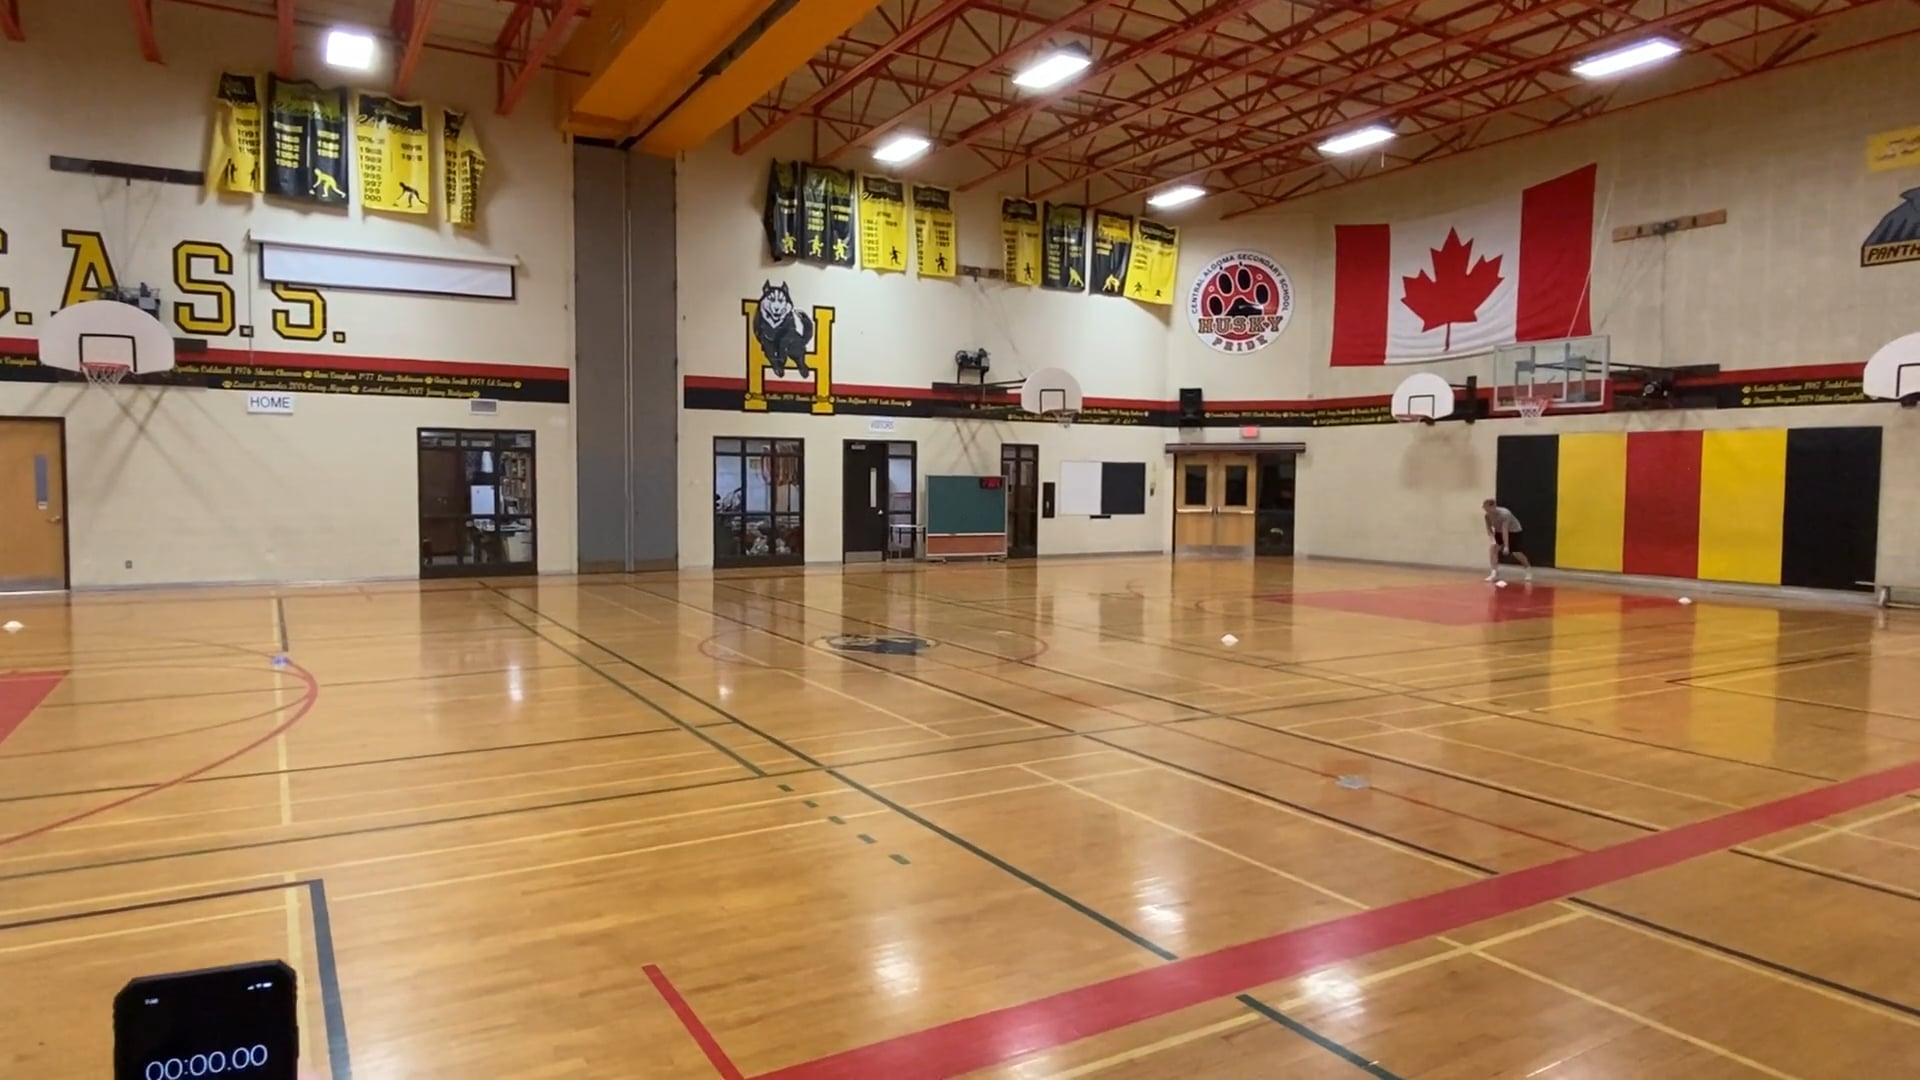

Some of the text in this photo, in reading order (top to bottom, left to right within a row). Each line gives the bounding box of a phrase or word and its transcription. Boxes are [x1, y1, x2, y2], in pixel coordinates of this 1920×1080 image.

[1204, 256, 1235, 278] ALGOMA
[1237, 254, 1283, 277] SECONDARY
[1191, 280, 1203, 314] CENTRAL
[1280, 278, 1290, 311] SCHOOL
[1198, 316, 1283, 334] HUSKY
[1212, 335, 1268, 352] PRIDE
[250, 396, 290, 408] HOME
[146, 1044, 268, 1080] 00:00.00
